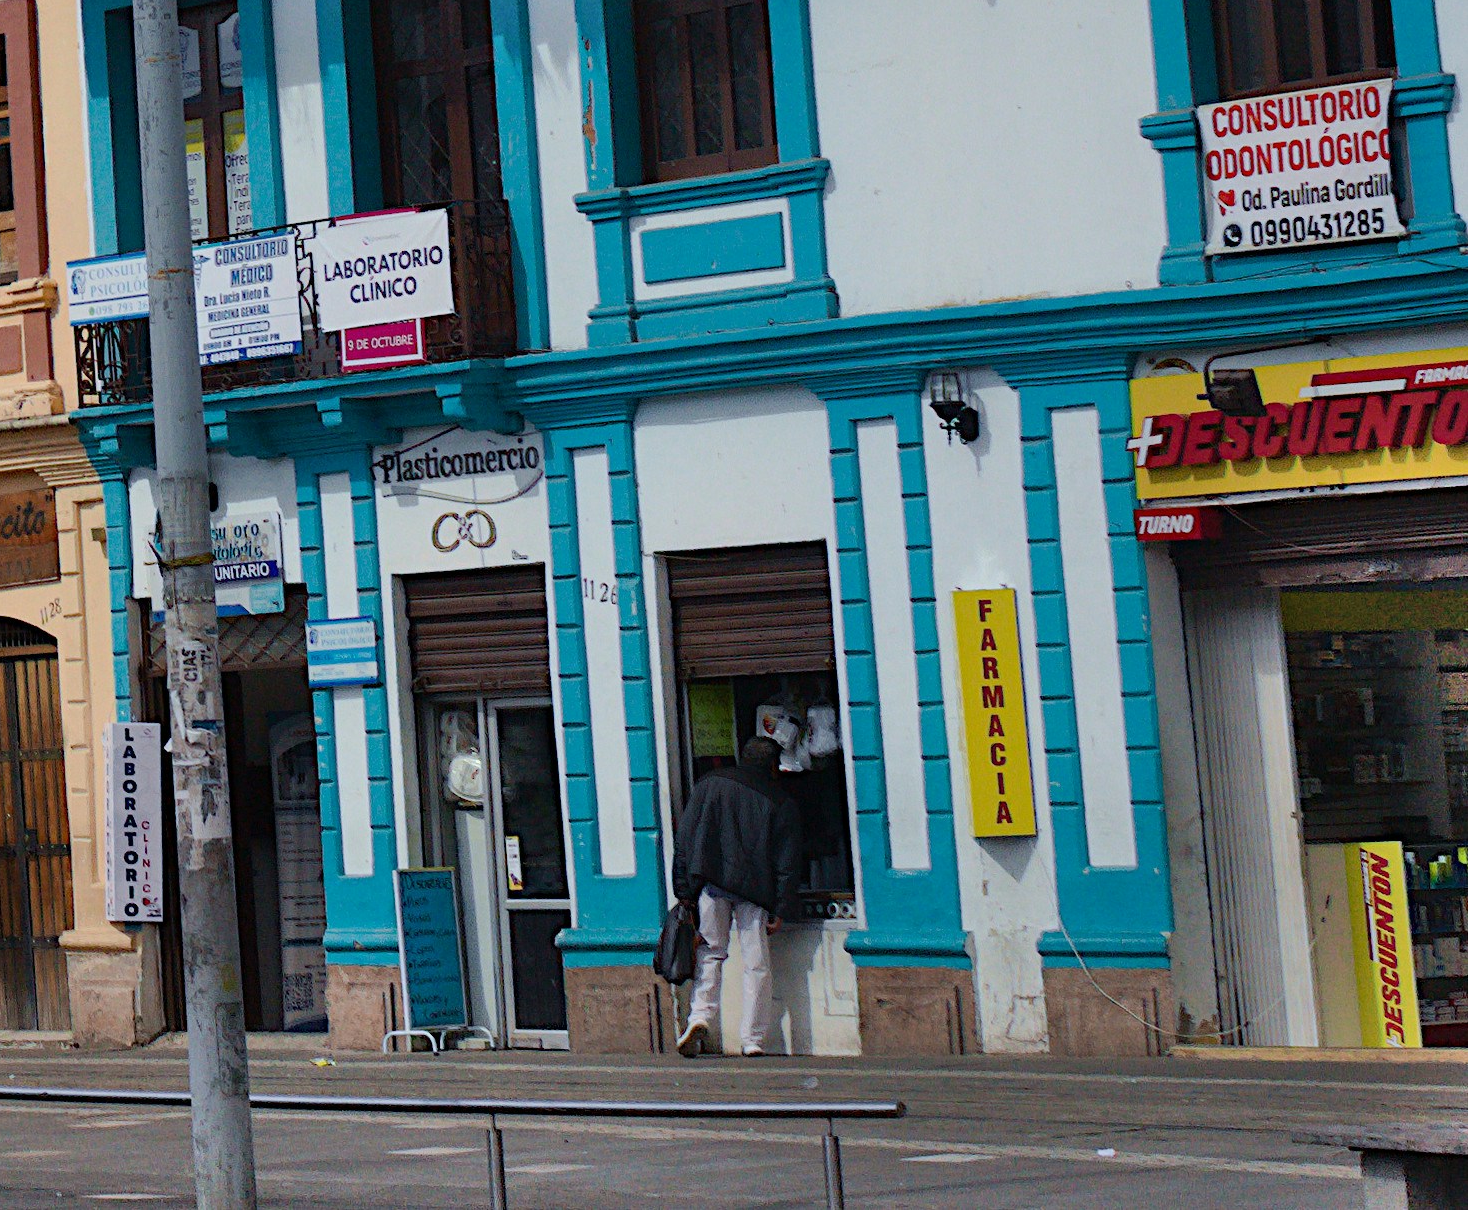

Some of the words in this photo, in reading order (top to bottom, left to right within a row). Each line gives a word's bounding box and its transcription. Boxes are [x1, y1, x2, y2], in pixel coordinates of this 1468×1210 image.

[1212, 86, 1380, 137] CONSULTORIO
[1205, 127, 1391, 181] ODONTOLÓGICO
[1242, 188, 1267, 212] Od.
[1270, 181, 1331, 209] Paulina
[1334, 173, 1391, 202] Gordill
[1250, 207, 1386, 248] 0990431285
[214, 238, 289, 267] CONSULTORIO
[324, 245, 443, 282] LABORATORIO
[230, 261, 273, 288] MÉDICO
[350, 276, 417, 303] CLÍNICO
[347, 339, 354, 350] 9
[356, 338, 368, 350] DE
[371, 334, 413, 347] OCTUBRE
[381, 438, 541, 483] Plasticomercio
[1139, 514, 1194, 535] TURNO
[978, 599, 1013, 825] FARMACIA
[122, 727, 139, 917] LABORATORIO
